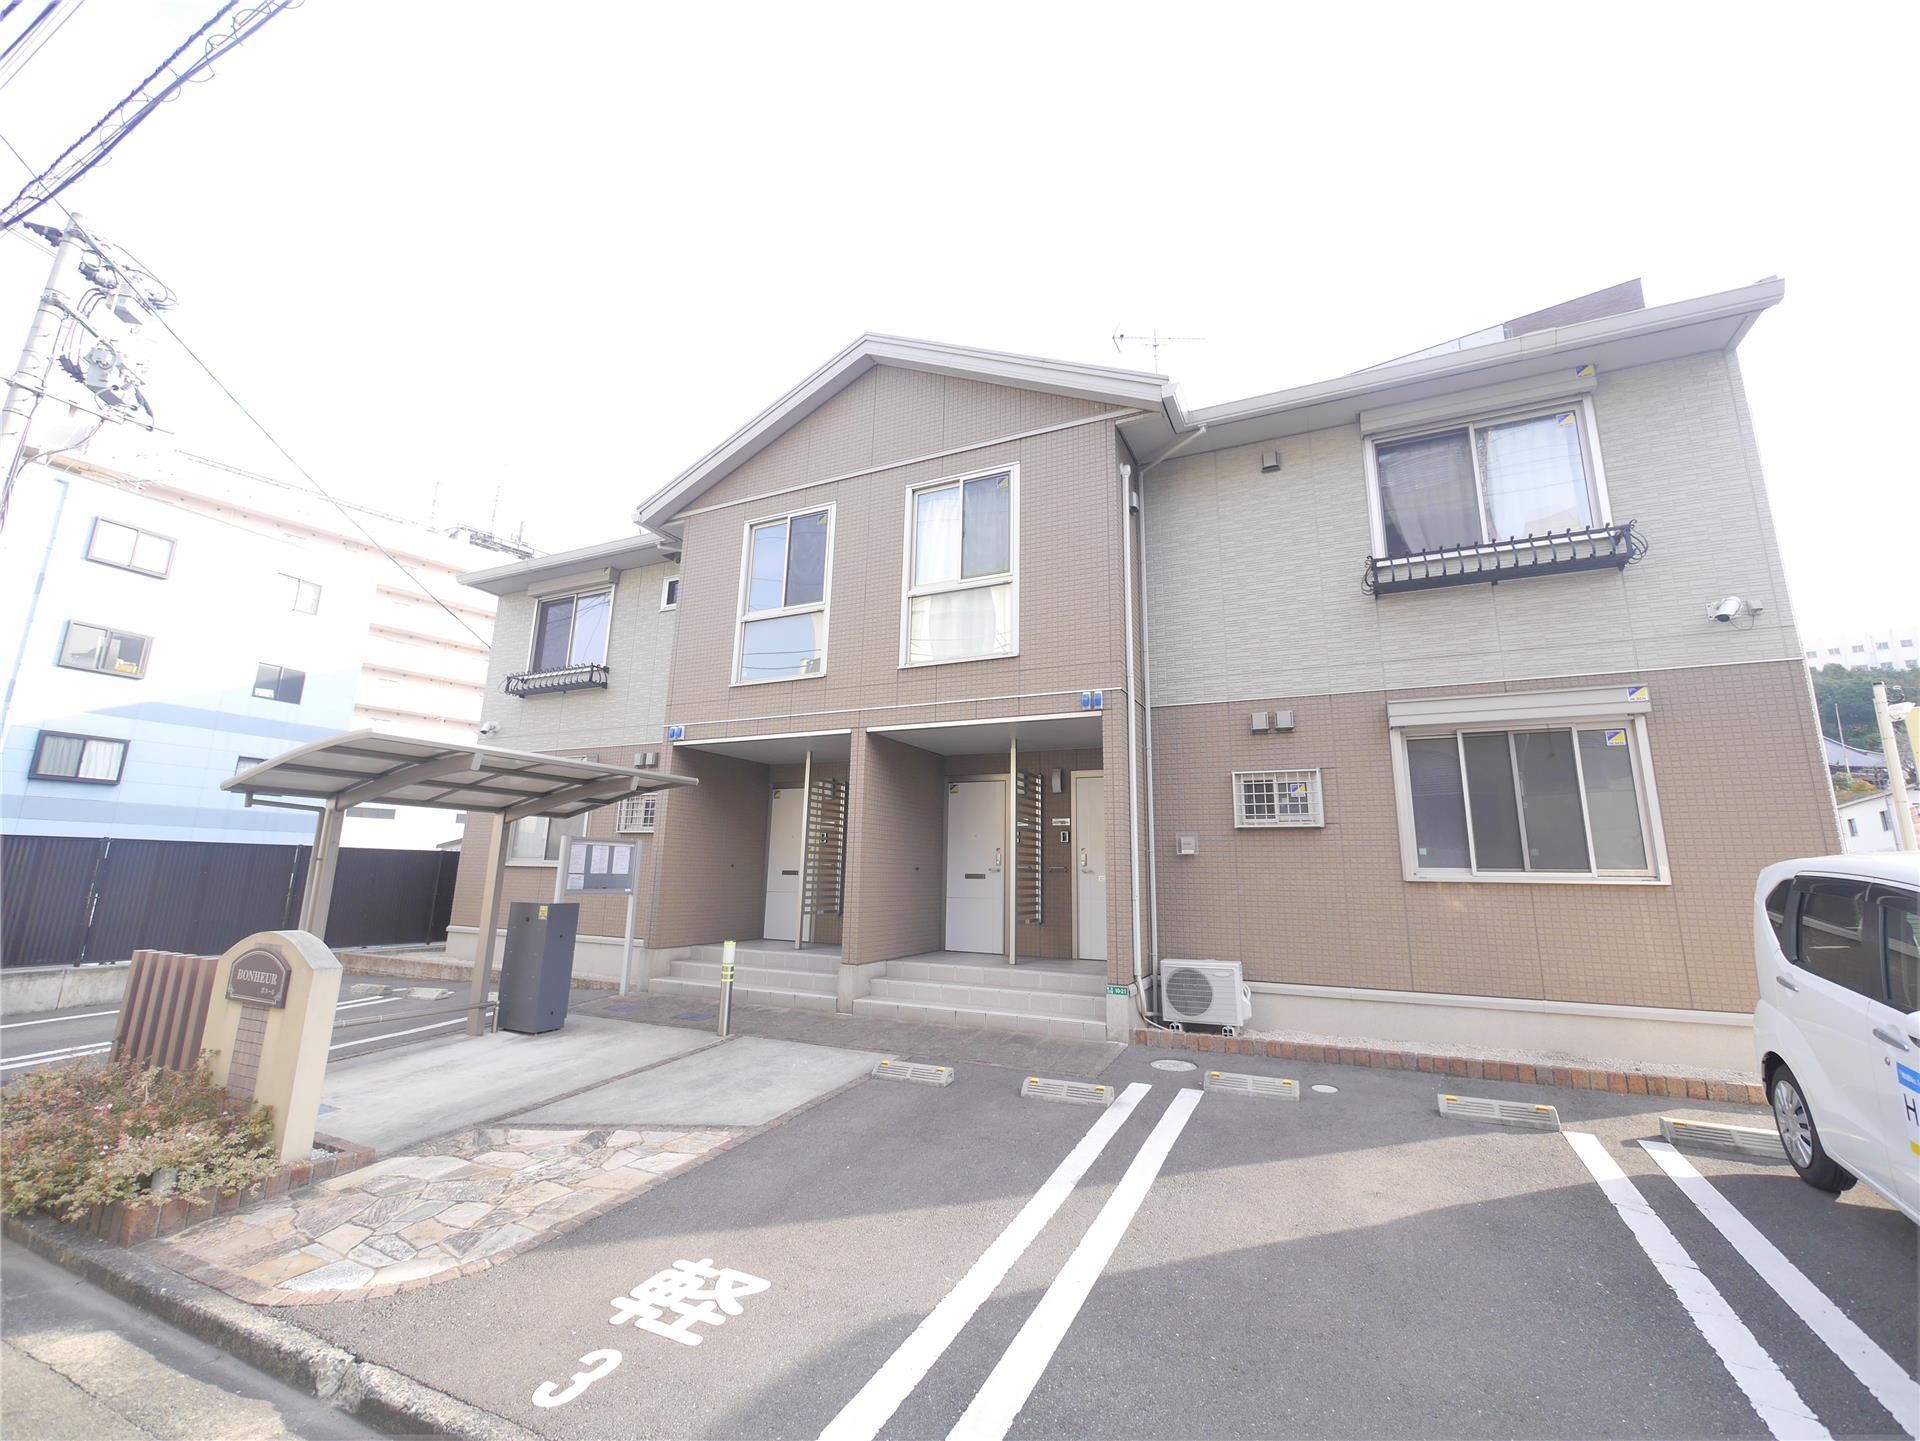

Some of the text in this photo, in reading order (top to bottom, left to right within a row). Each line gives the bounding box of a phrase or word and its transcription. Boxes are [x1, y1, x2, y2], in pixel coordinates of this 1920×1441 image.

[237, 968, 278, 985] BONHEUR
[609, 1258, 771, 1346] 軽
[531, 1348, 623, 1408] 3
